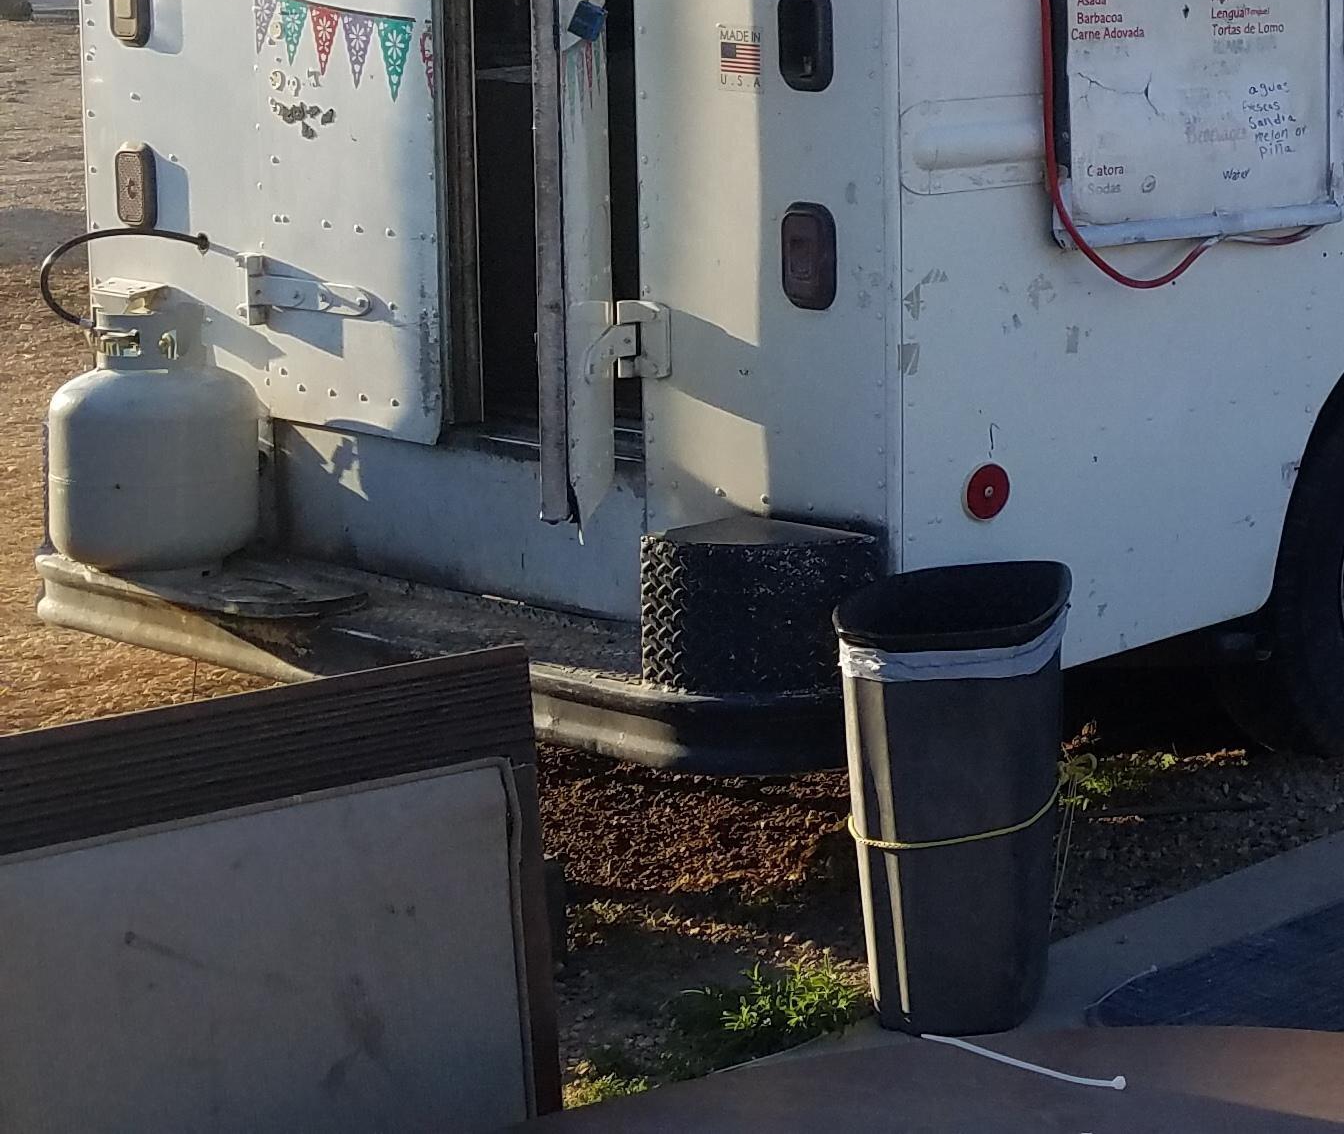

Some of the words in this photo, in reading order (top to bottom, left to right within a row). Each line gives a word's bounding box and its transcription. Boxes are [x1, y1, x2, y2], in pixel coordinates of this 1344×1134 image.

[1077, 12, 1123, 24] Barbacoa
[1211, 7, 1244, 20] Lengua
[720, 29, 749, 42] MADE
[751, 31, 761, 43] IN
[1071, 28, 1101, 41] Carne
[1103, 26, 1145, 39] Adovada
[1211, 23, 1241, 36] Tortas
[1243, 22, 1256, 34] de
[1258, 22, 1285, 34] Lomo
